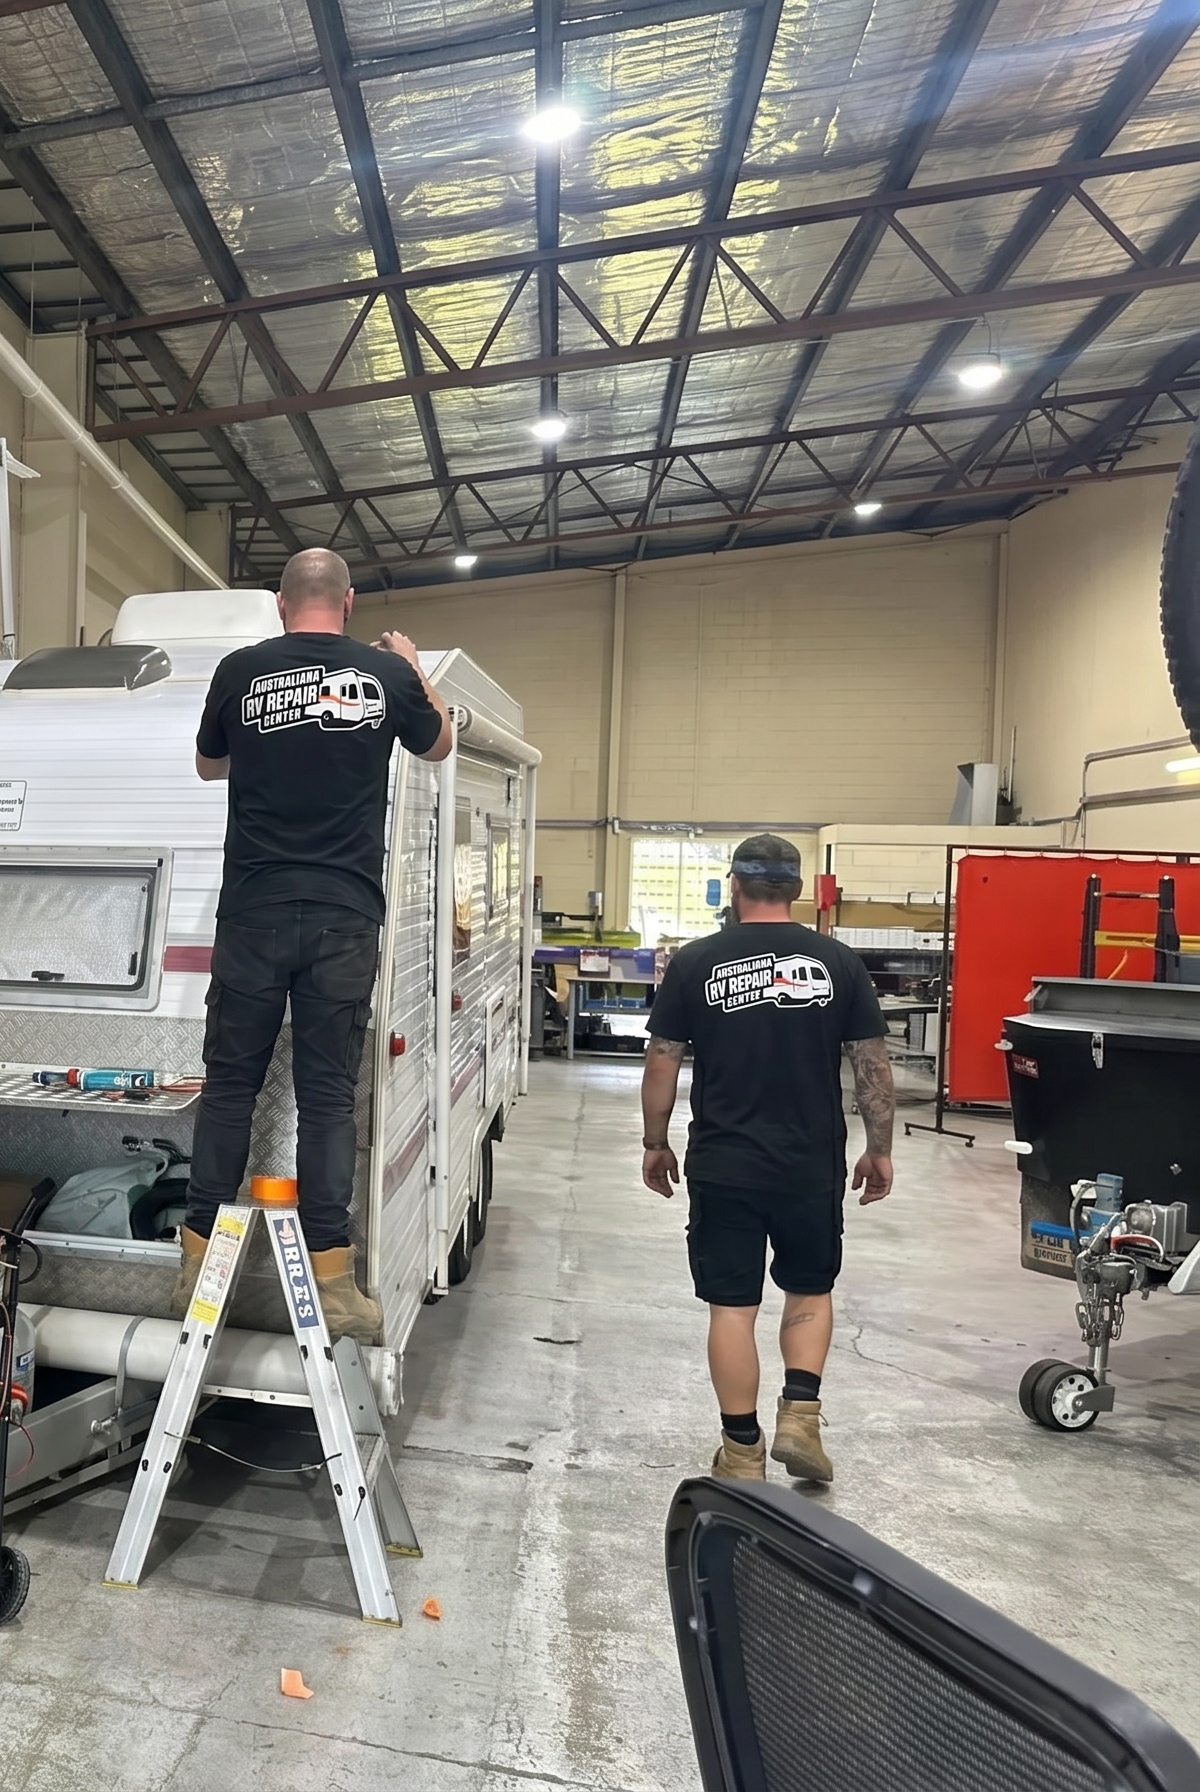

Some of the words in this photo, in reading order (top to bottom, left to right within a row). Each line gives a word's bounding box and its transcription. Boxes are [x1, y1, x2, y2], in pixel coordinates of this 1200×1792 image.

[246, 697, 265, 719] RV
[266, 684, 318, 713] REPAIR
[263, 709, 302, 727] CENTER
[709, 979, 727, 1001] RV
[728, 969, 773, 995] REPAIR
